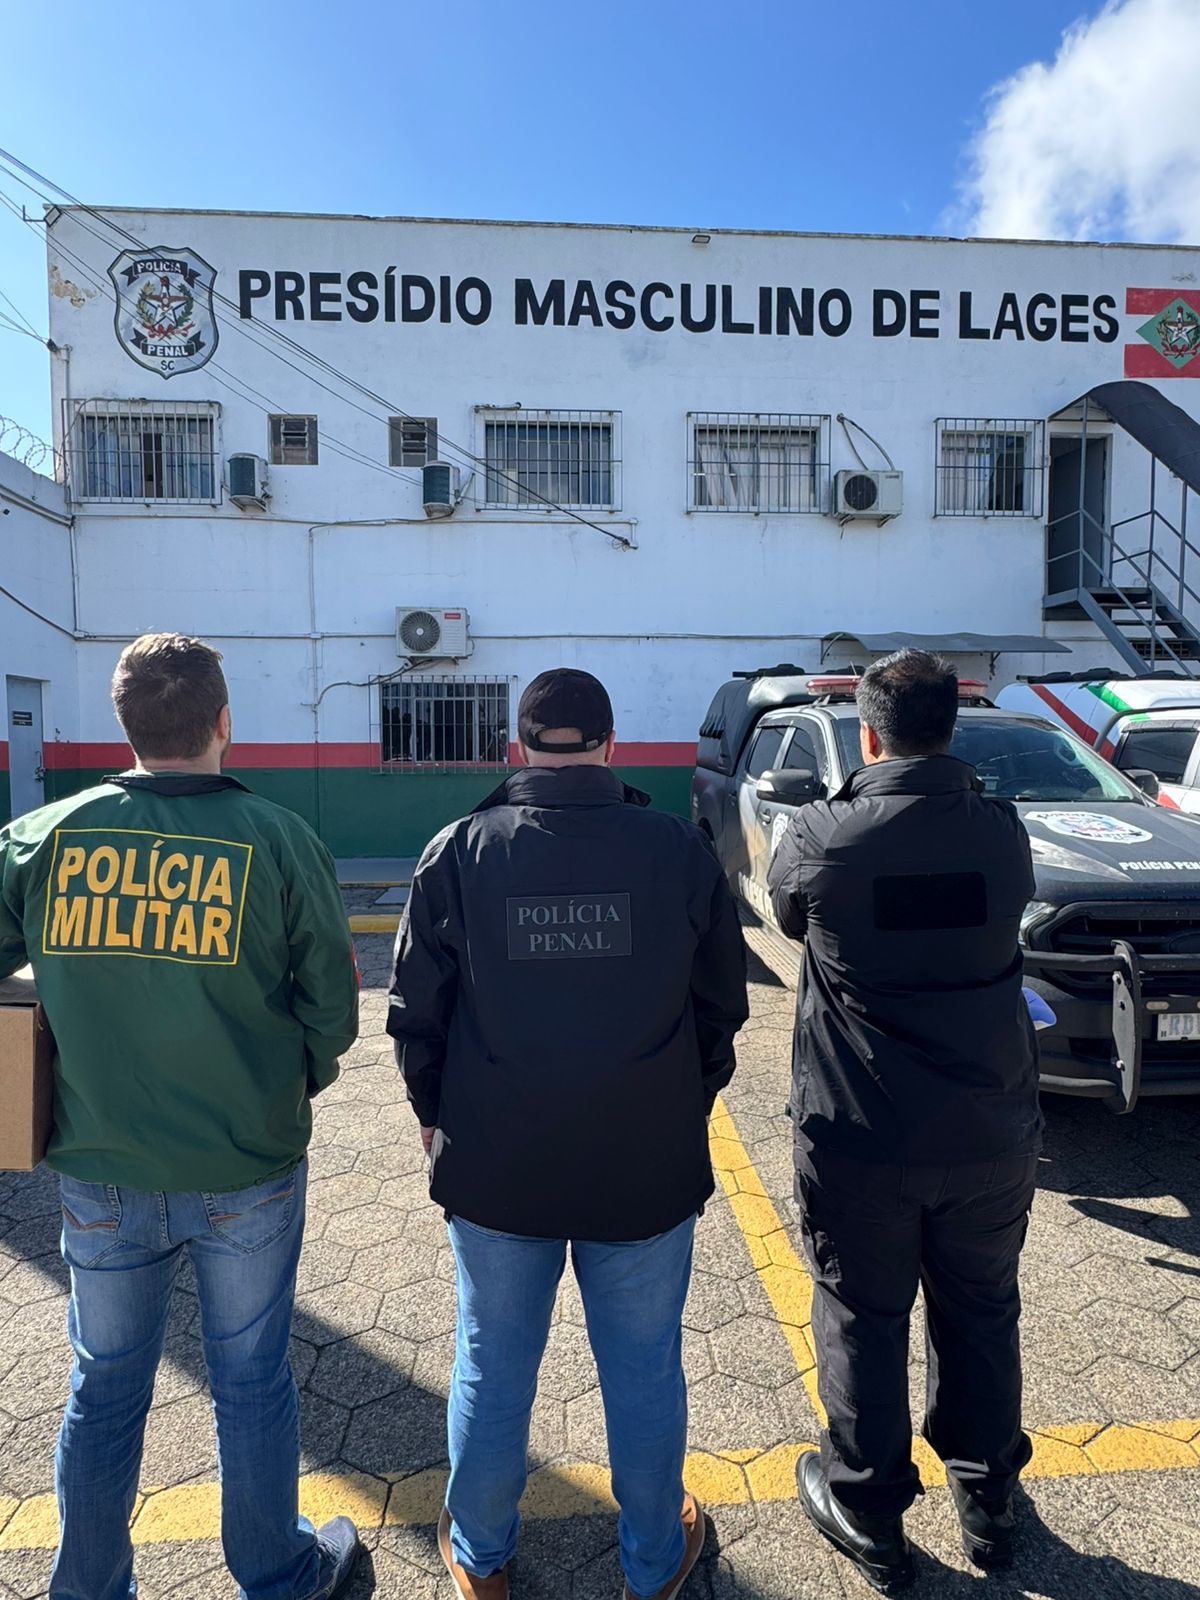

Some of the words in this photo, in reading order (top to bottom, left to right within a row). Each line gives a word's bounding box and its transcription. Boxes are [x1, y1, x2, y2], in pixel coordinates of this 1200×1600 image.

[239, 266, 492, 326] PRESÍDIO
[515, 278, 852, 337] MASCULINO
[873, 289, 940, 338] DE
[959, 292, 1119, 343] LAGES
[147, 345, 188, 356] PENAL
[160, 360, 175, 370] SC
[58, 839, 233, 906] POLÍCIA
[1118, 860, 1177, 871] POLÍCIA
[518, 900, 621, 925] POLÍCIA
[50, 896, 233, 956] MILITAR
[528, 931, 611, 952] PENAL
